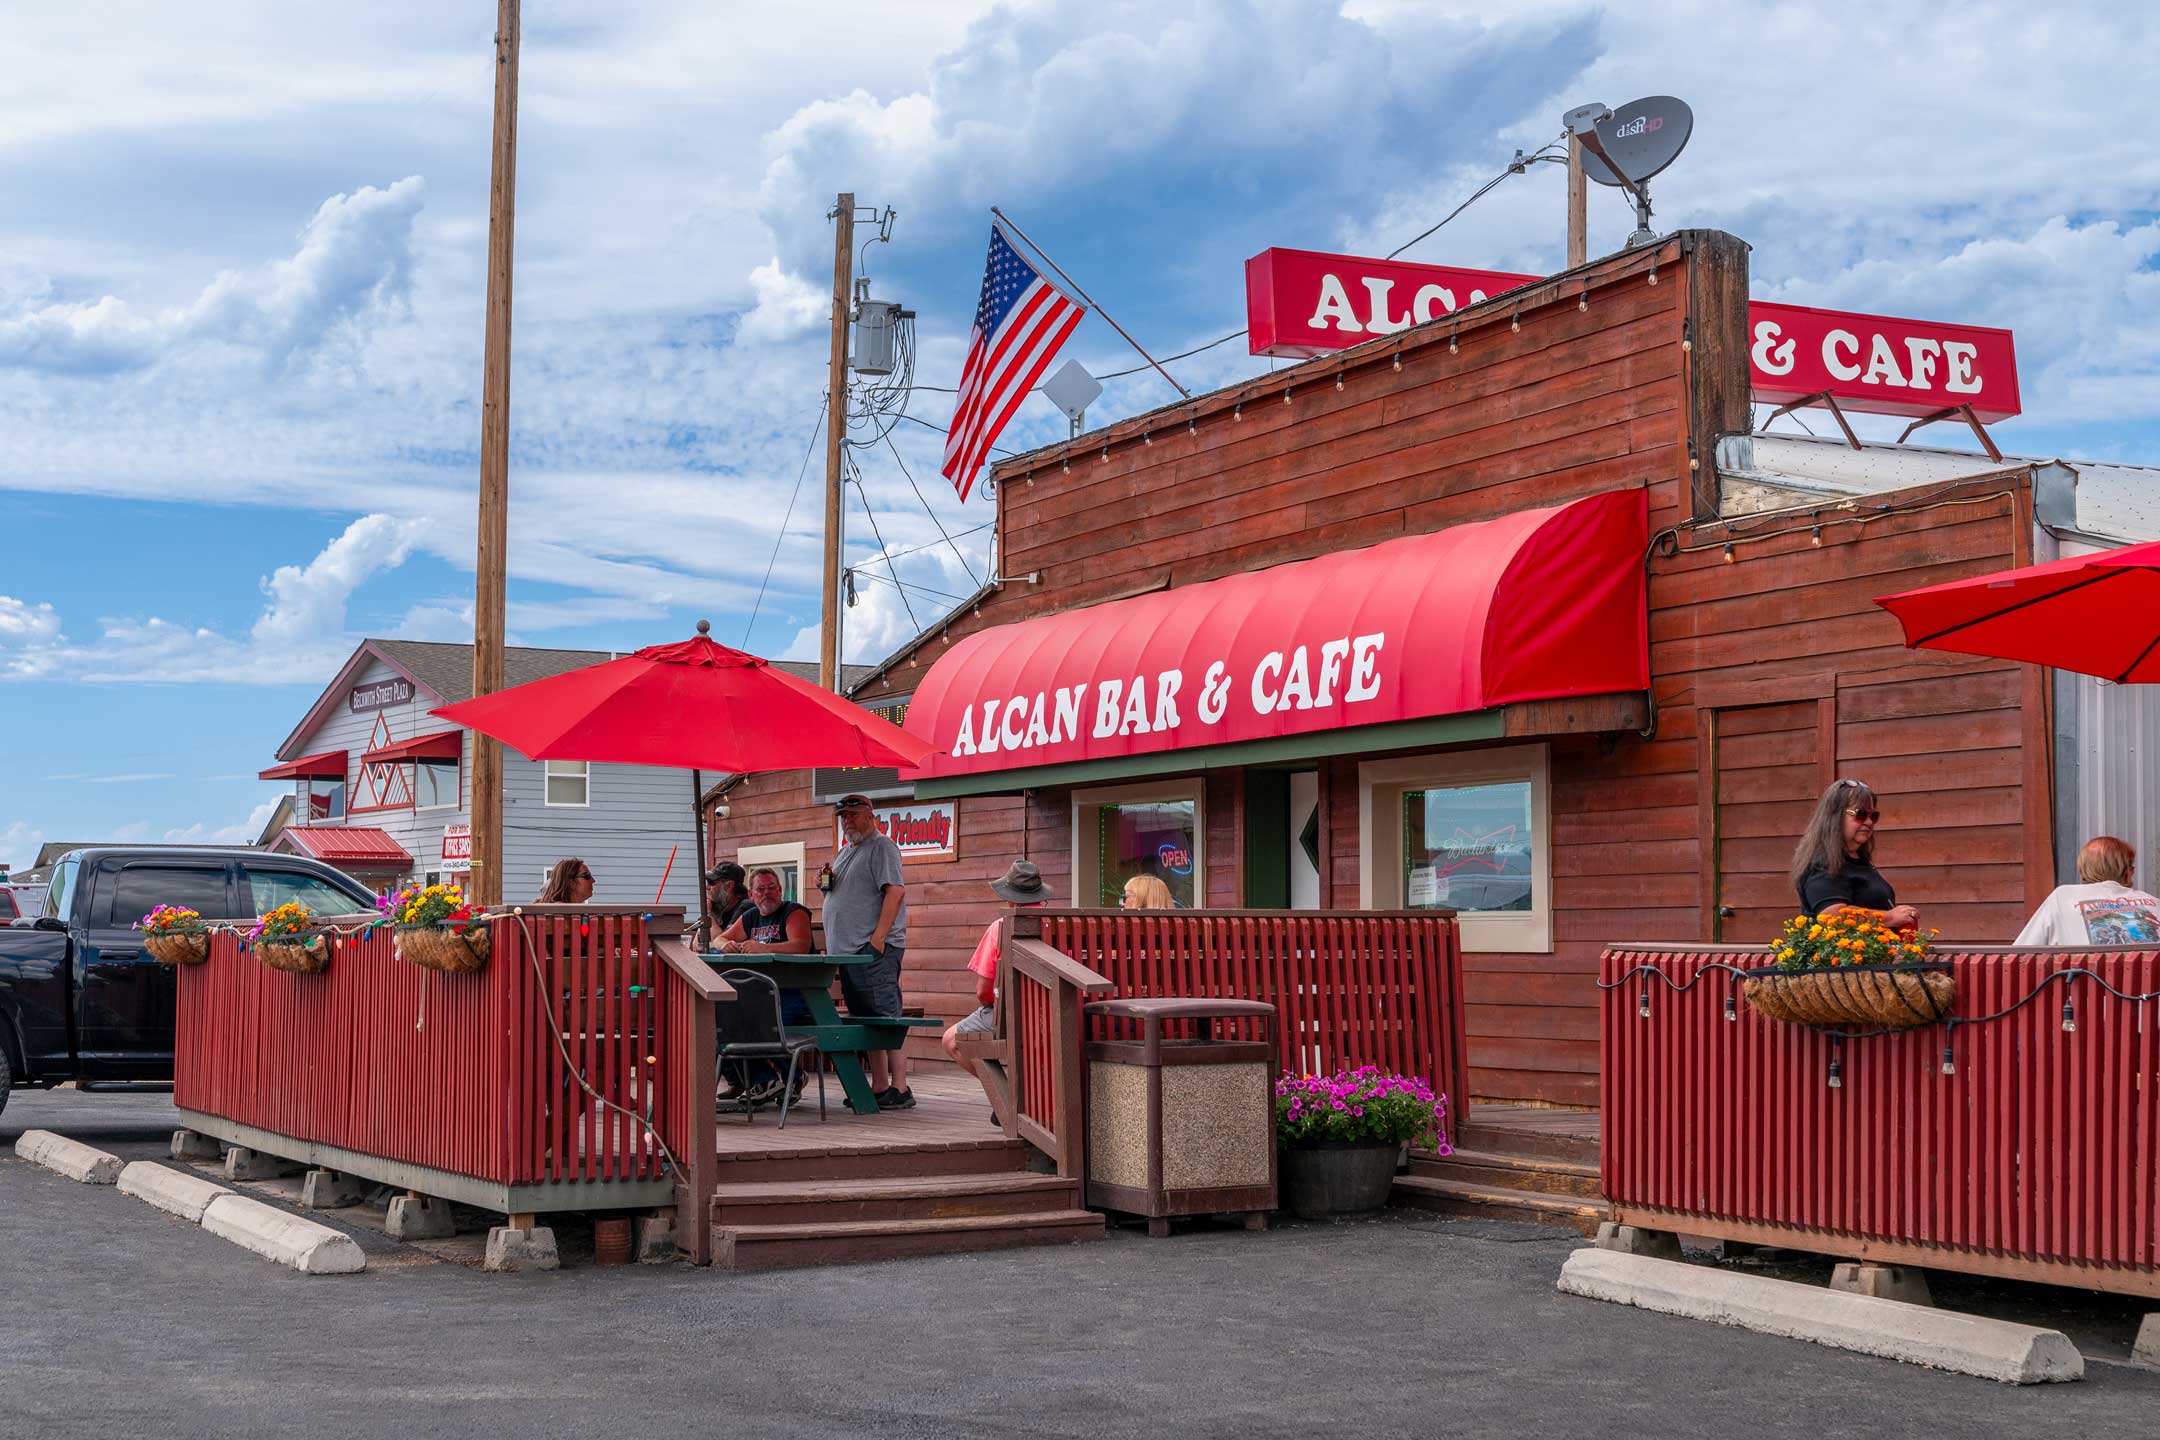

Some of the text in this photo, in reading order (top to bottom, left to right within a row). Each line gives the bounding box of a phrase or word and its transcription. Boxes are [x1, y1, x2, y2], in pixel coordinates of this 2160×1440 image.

[1616, 115, 1647, 138] dish
[1307, 273, 1984, 395] ALC & CAFE
[375, 685, 393, 705] STREET
[393, 682, 409, 701] PLAZA
[951, 631, 1385, 757] ALCAN BAR & CAFE
[890, 809, 951, 850] Friendly
[1161, 849, 1188, 869] OPEN
